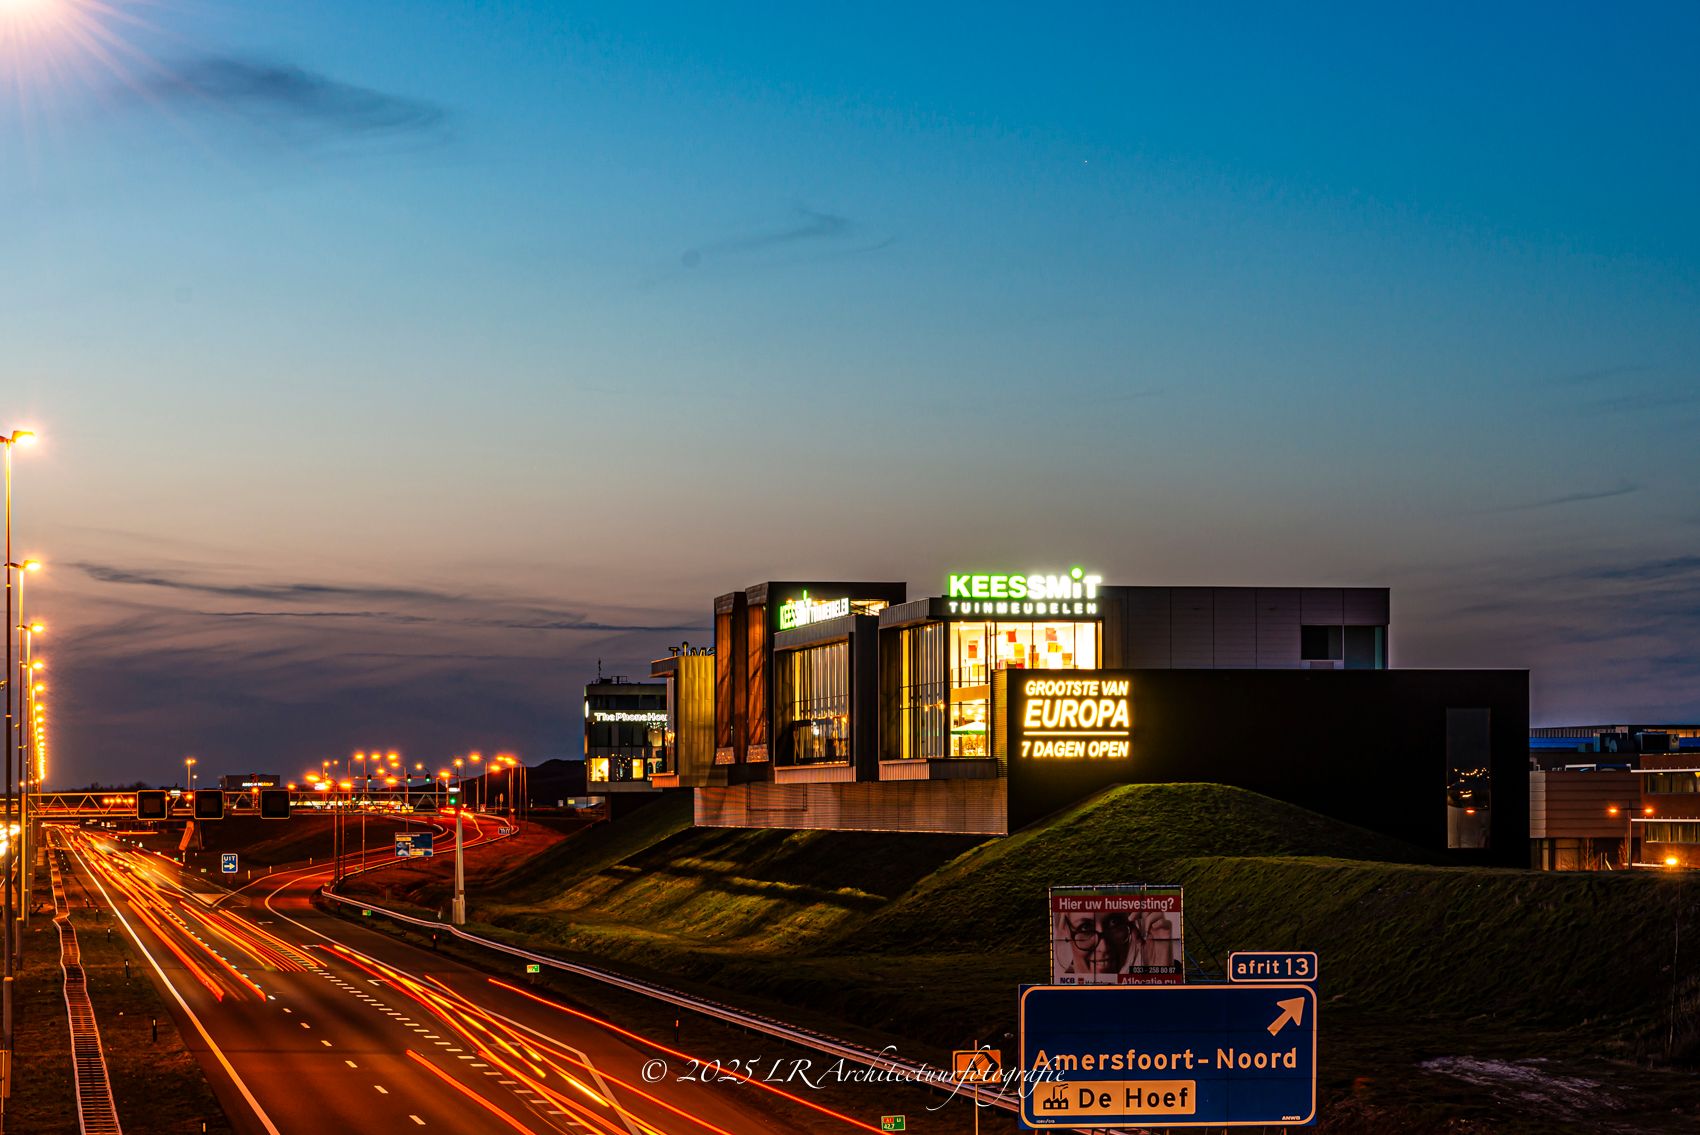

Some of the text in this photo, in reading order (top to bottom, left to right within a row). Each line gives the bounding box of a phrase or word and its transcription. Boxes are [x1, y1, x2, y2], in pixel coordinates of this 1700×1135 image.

[949, 602, 1097, 615] TUINMEUBELEN
[1025, 680, 1129, 696] GROOTSTE VAN
[1024, 699, 1130, 728] EUROPA
[1021, 741, 1130, 757] 7 DAGEN OPEN
[1059, 897, 1175, 912] Hier uw huisvesting?
[1237, 957, 1310, 977] afrit 13
[1032, 1047, 1297, 1071] Amersfoort-Noord
[1078, 1087, 1189, 1109] De Hoef
